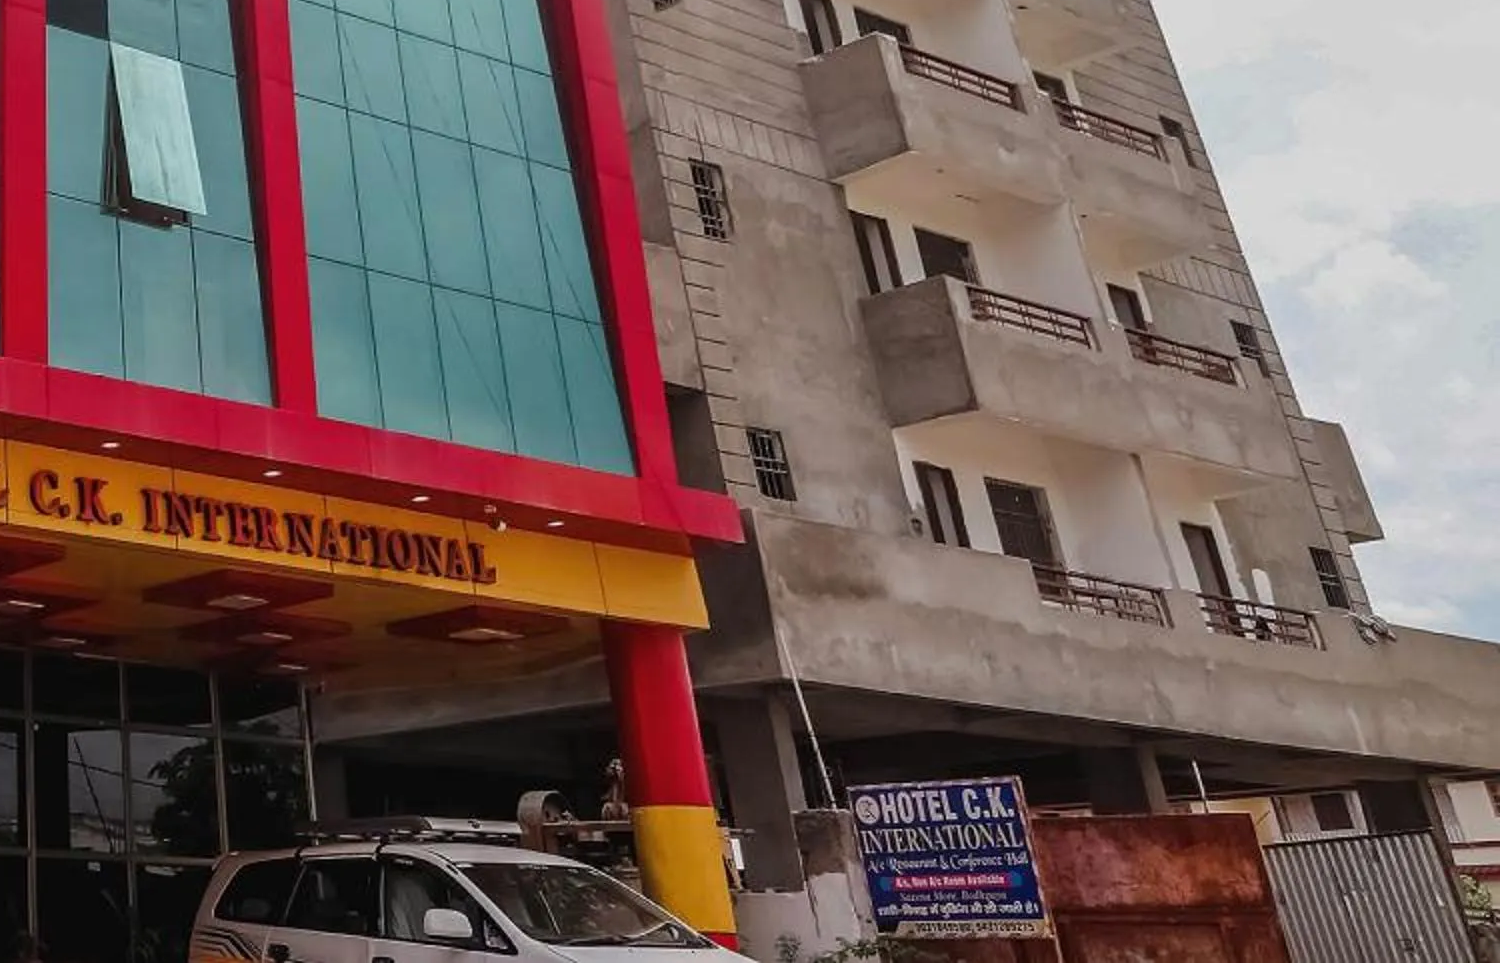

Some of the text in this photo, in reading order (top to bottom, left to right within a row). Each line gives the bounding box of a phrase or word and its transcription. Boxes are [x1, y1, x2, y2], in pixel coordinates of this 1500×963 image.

[29, 469, 123, 525] C.K.
[141, 488, 497, 584] INTERNATIONAL
[879, 790, 958, 824] HOTEL
[962, 787, 1015, 819] C.K.
[860, 822, 1024, 854] INTERNATIONAL
